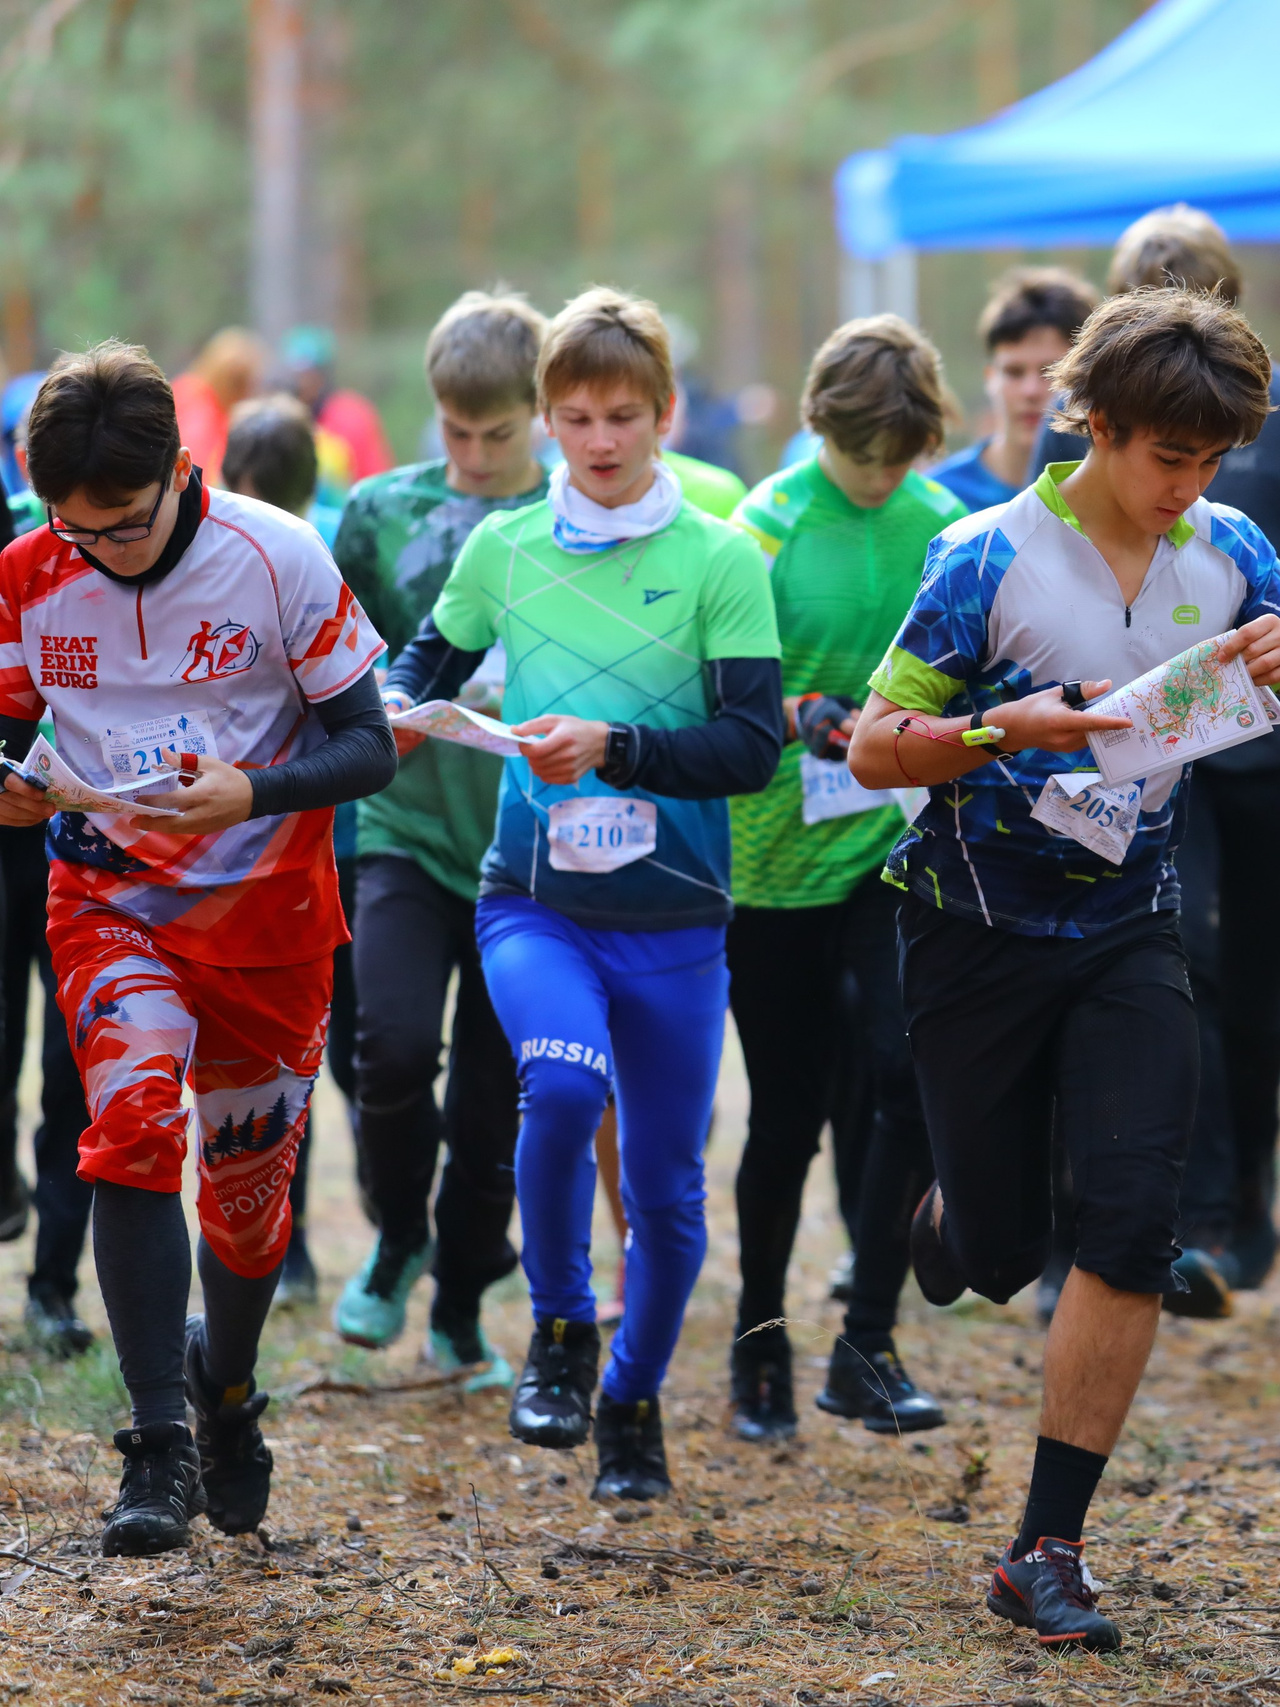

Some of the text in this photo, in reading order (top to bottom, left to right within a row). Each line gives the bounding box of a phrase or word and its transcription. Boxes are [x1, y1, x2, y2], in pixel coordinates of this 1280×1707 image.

[39, 635, 98, 654] EKAT
[39, 653, 98, 672] ERIN
[39, 671, 98, 690] BURG
[1069, 789, 1120, 828] 205
[577, 824, 624, 848] 210
[520, 1037, 608, 1075] RUSSIA
[212, 1156, 283, 1200] СПОРТИВНАЯ
